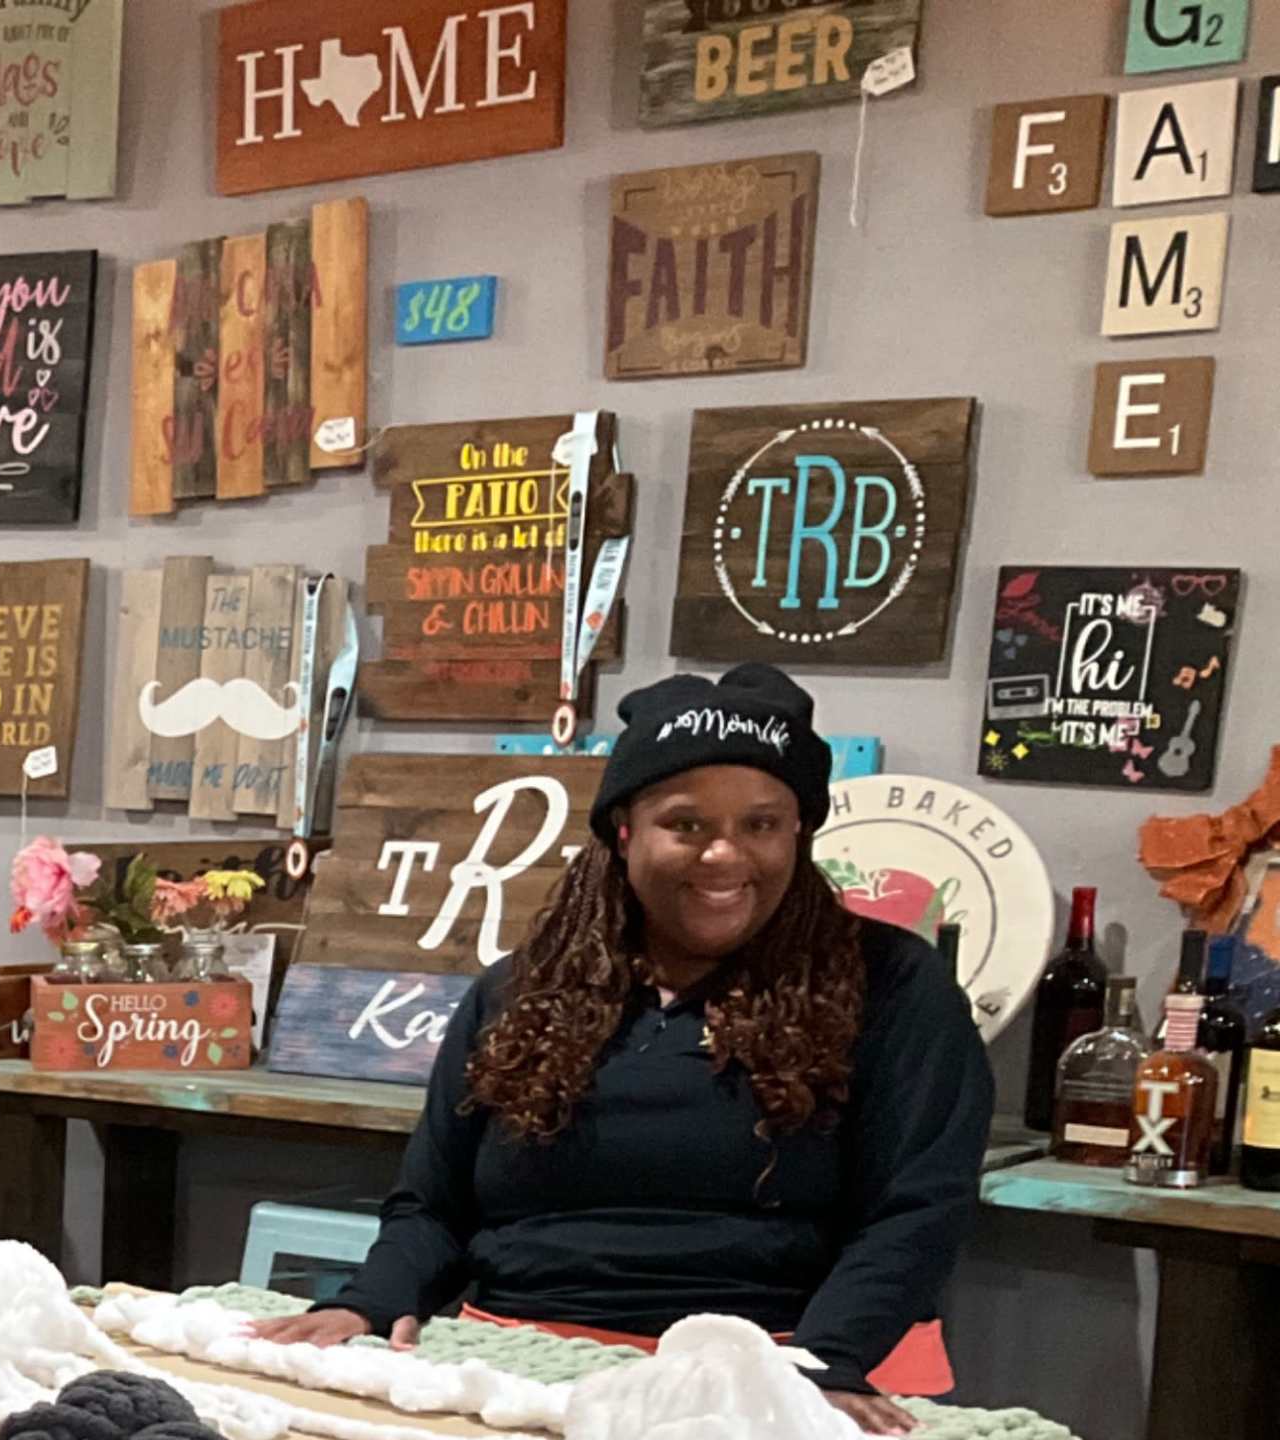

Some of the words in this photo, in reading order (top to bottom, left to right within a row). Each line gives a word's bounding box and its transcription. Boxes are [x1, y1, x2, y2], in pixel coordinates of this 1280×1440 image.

[695, 15, 853, 102] BEER
[608, 193, 806, 352] FAITH
[404, 281, 480, 335] $48
[26, 317, 63, 365] is
[446, 479, 539, 519] PATIO
[1079, 592, 1113, 616] IT'S
[1116, 595, 1145, 616] ME
[159, 626, 290, 652] MUSTACHE
[1072, 618, 1135, 694] hi
[25, 645, 58, 677] IS
[12, 684, 55, 715] IN
[1067, 699, 1090, 715] THE
[1093, 699, 1153, 719] PROBLEM
[1099, 723, 1127, 747] ME
[887, 786, 1014, 862] BAKED
[110, 993, 168, 1013] HELLO
[77, 993, 209, 1069] Spring
